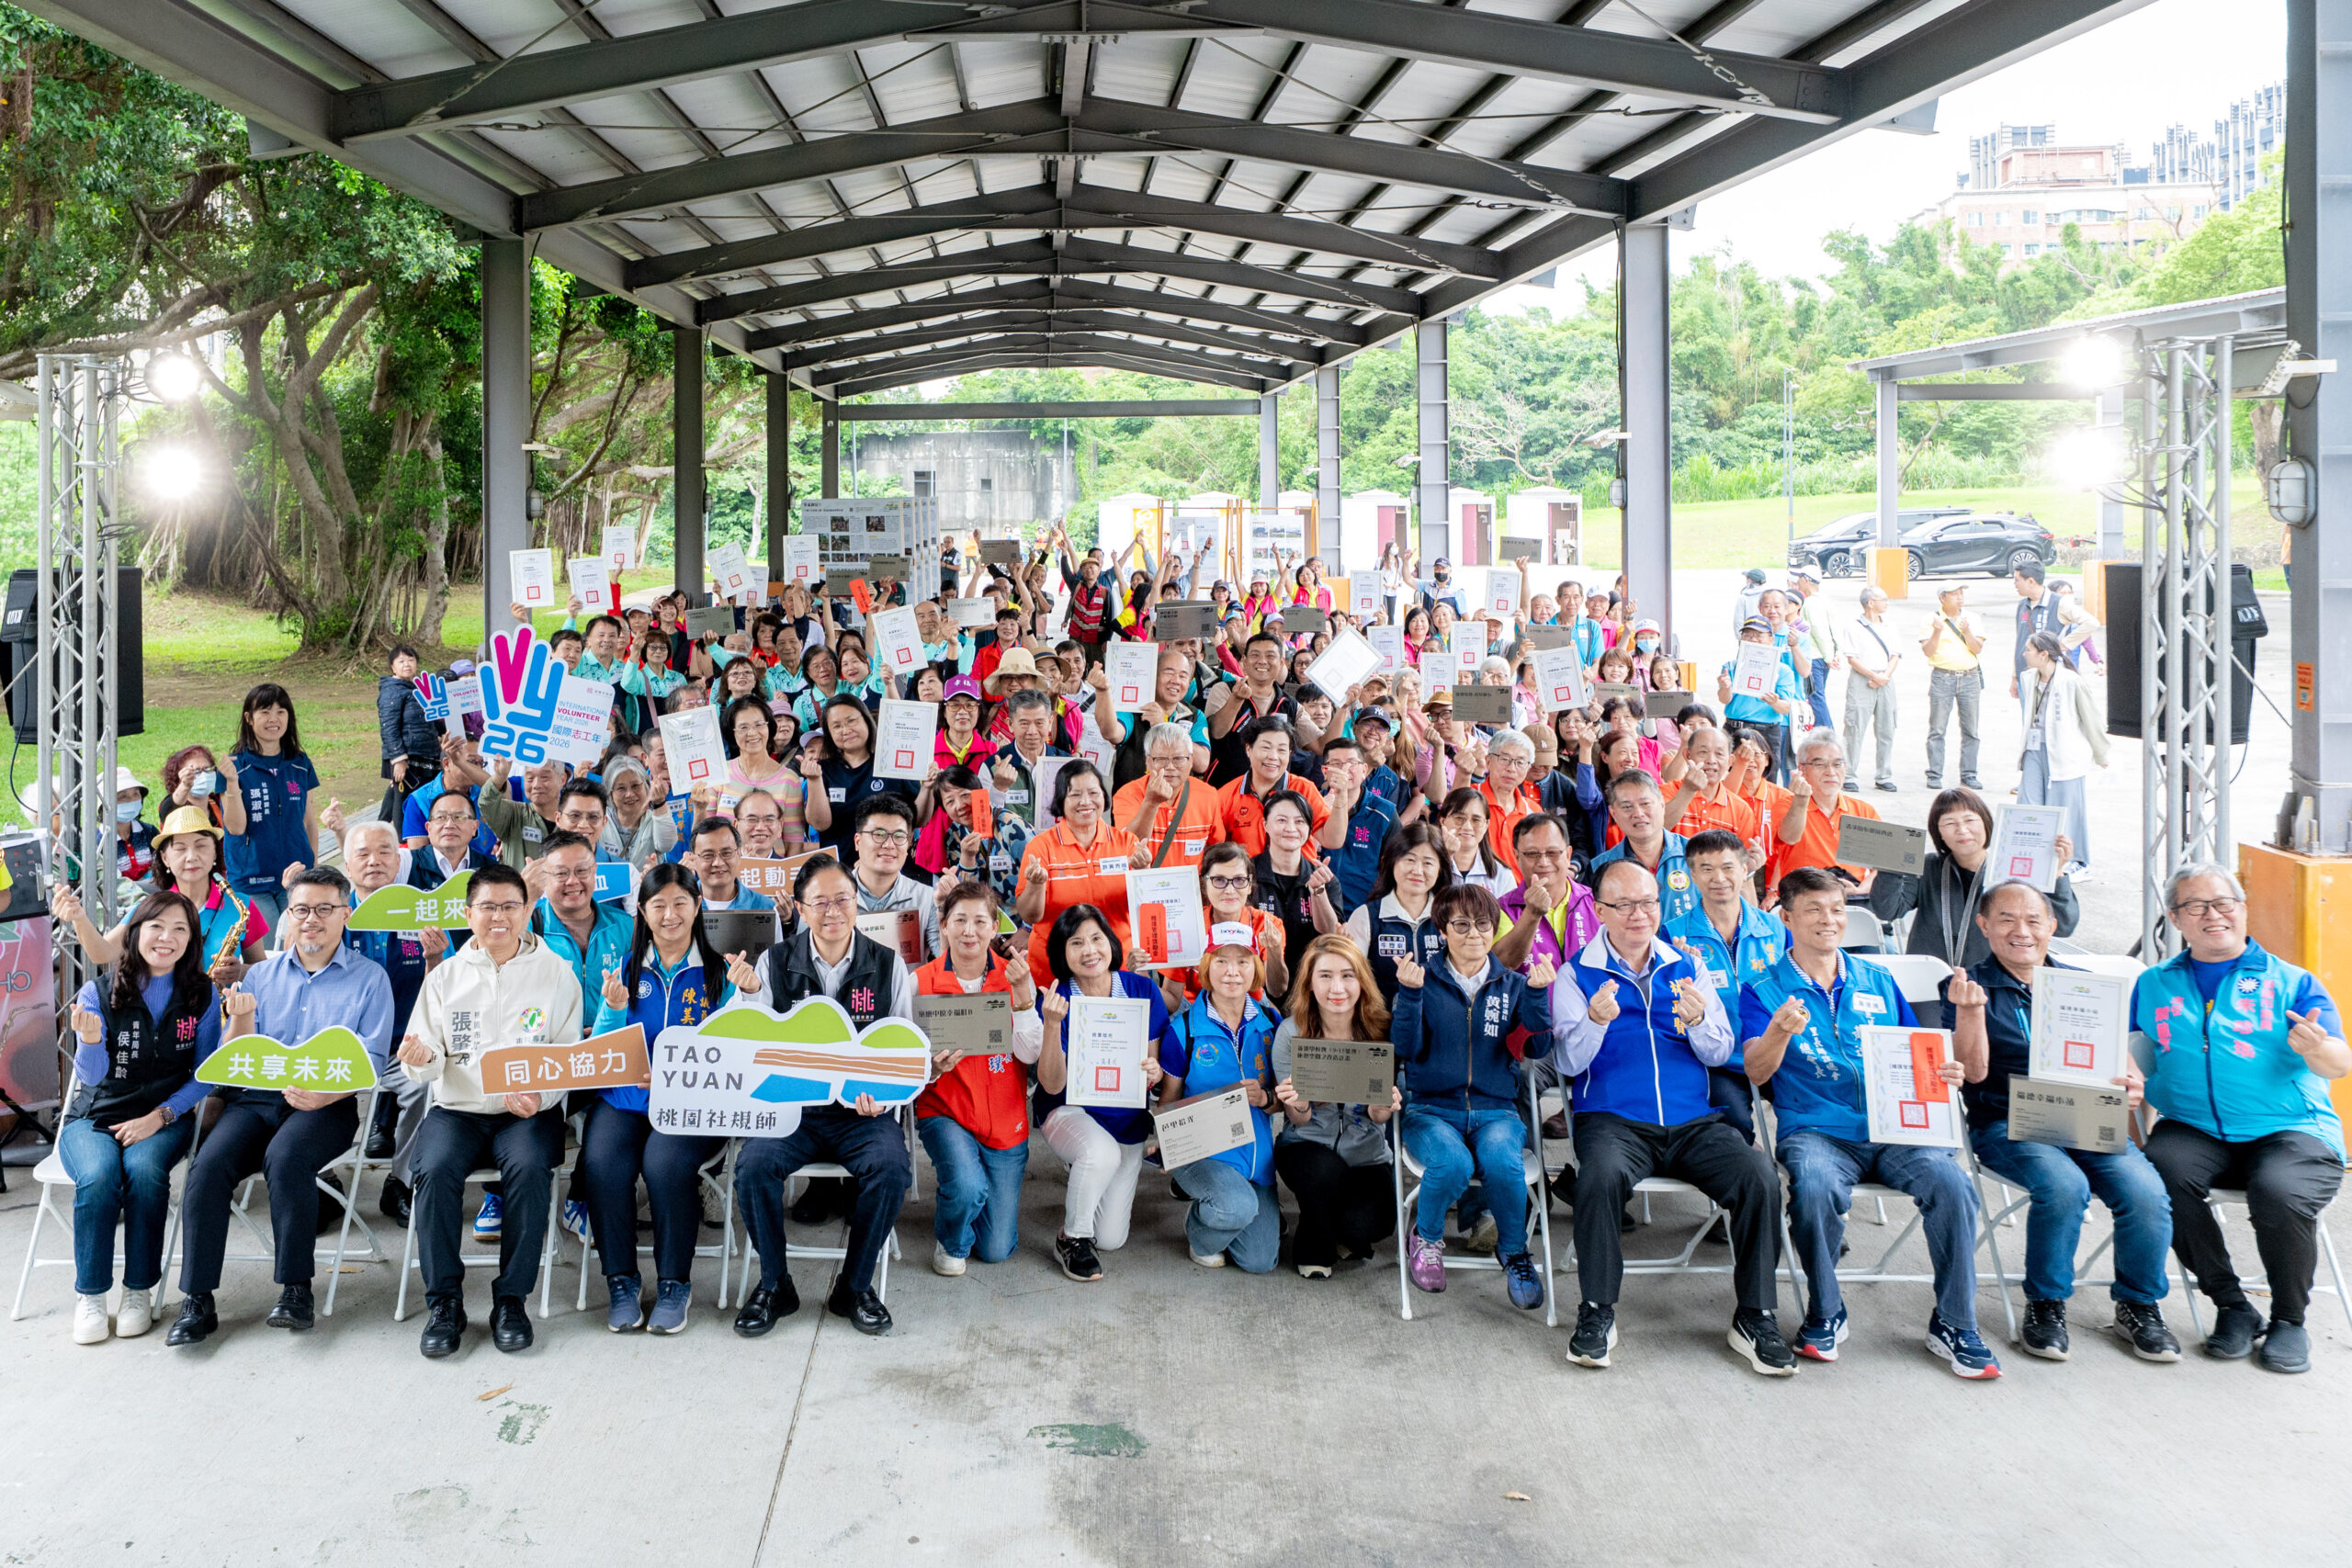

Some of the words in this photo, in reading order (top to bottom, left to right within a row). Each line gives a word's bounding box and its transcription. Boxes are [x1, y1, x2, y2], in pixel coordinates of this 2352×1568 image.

[425, 705, 450, 720] 26
[558, 706, 600, 723] VOLUNTEER
[559, 700, 608, 716] INTERNATIONAL
[556, 714, 573, 725] YEAR
[573, 716, 589, 727] 2026
[482, 723, 548, 764] 26
[548, 736, 571, 749] 2026
[551, 723, 603, 744] 國際志工年
[250, 788, 263, 822] 張淑華
[387, 897, 467, 922] 一起來
[1484, 995, 1501, 1038] 黃婉如
[130, 1021, 140, 1059] 青年局長
[114, 1031, 130, 1079] 侯佳齡
[663, 1044, 722, 1065] TAO
[228, 1052, 353, 1083] 共享未來
[503, 1048, 628, 1087] 同心協力
[662, 1070, 744, 1091] YUAN
[656, 1108, 777, 1132] 桃園社規師
